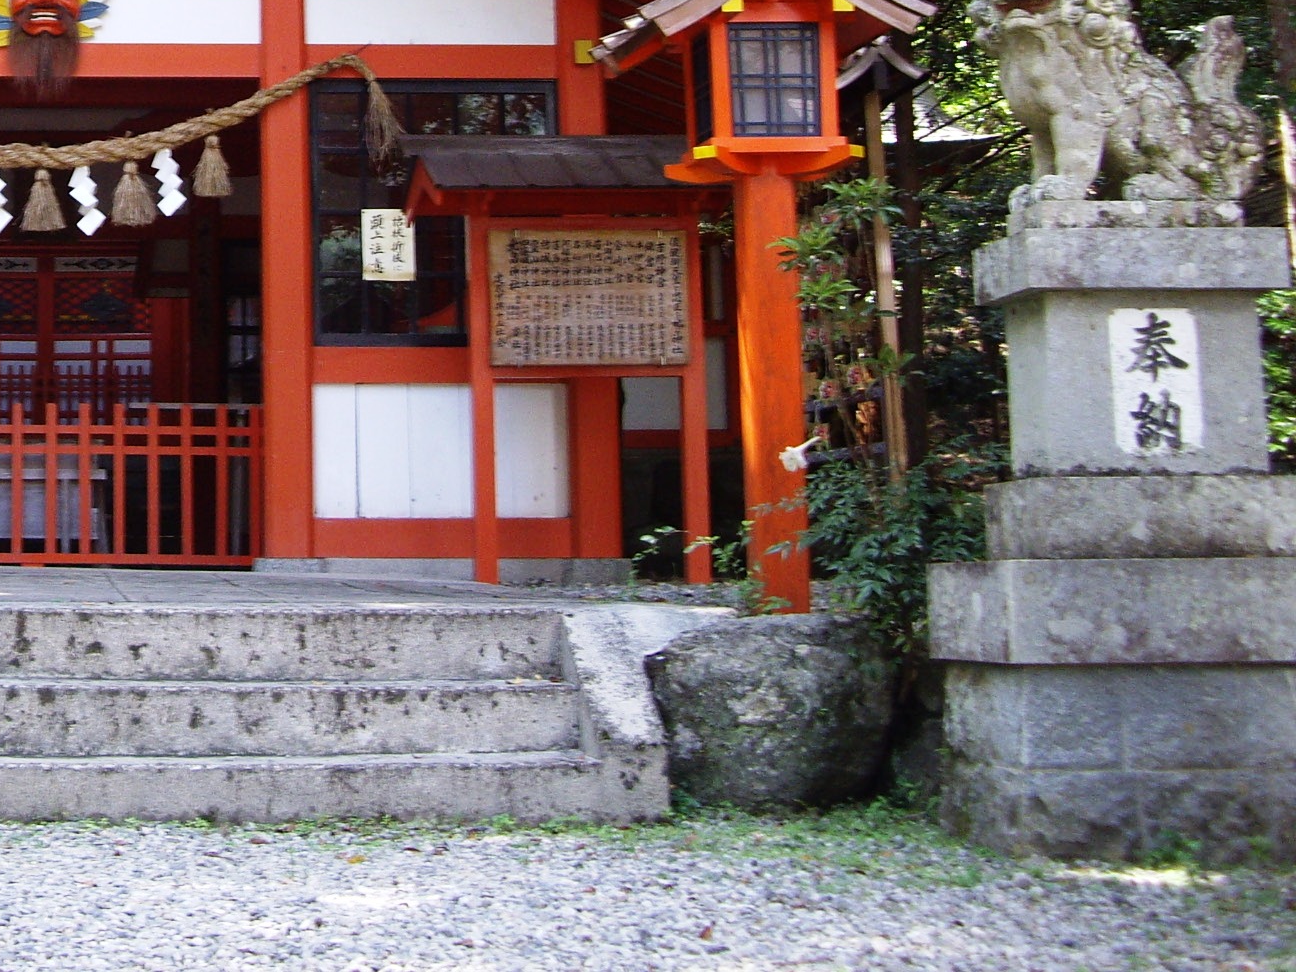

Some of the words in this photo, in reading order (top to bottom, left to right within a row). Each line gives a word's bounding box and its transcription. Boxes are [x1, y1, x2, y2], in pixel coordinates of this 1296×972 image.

[369, 213, 385, 274] 頭上注意
[1125, 311, 1189, 449] 奉納
